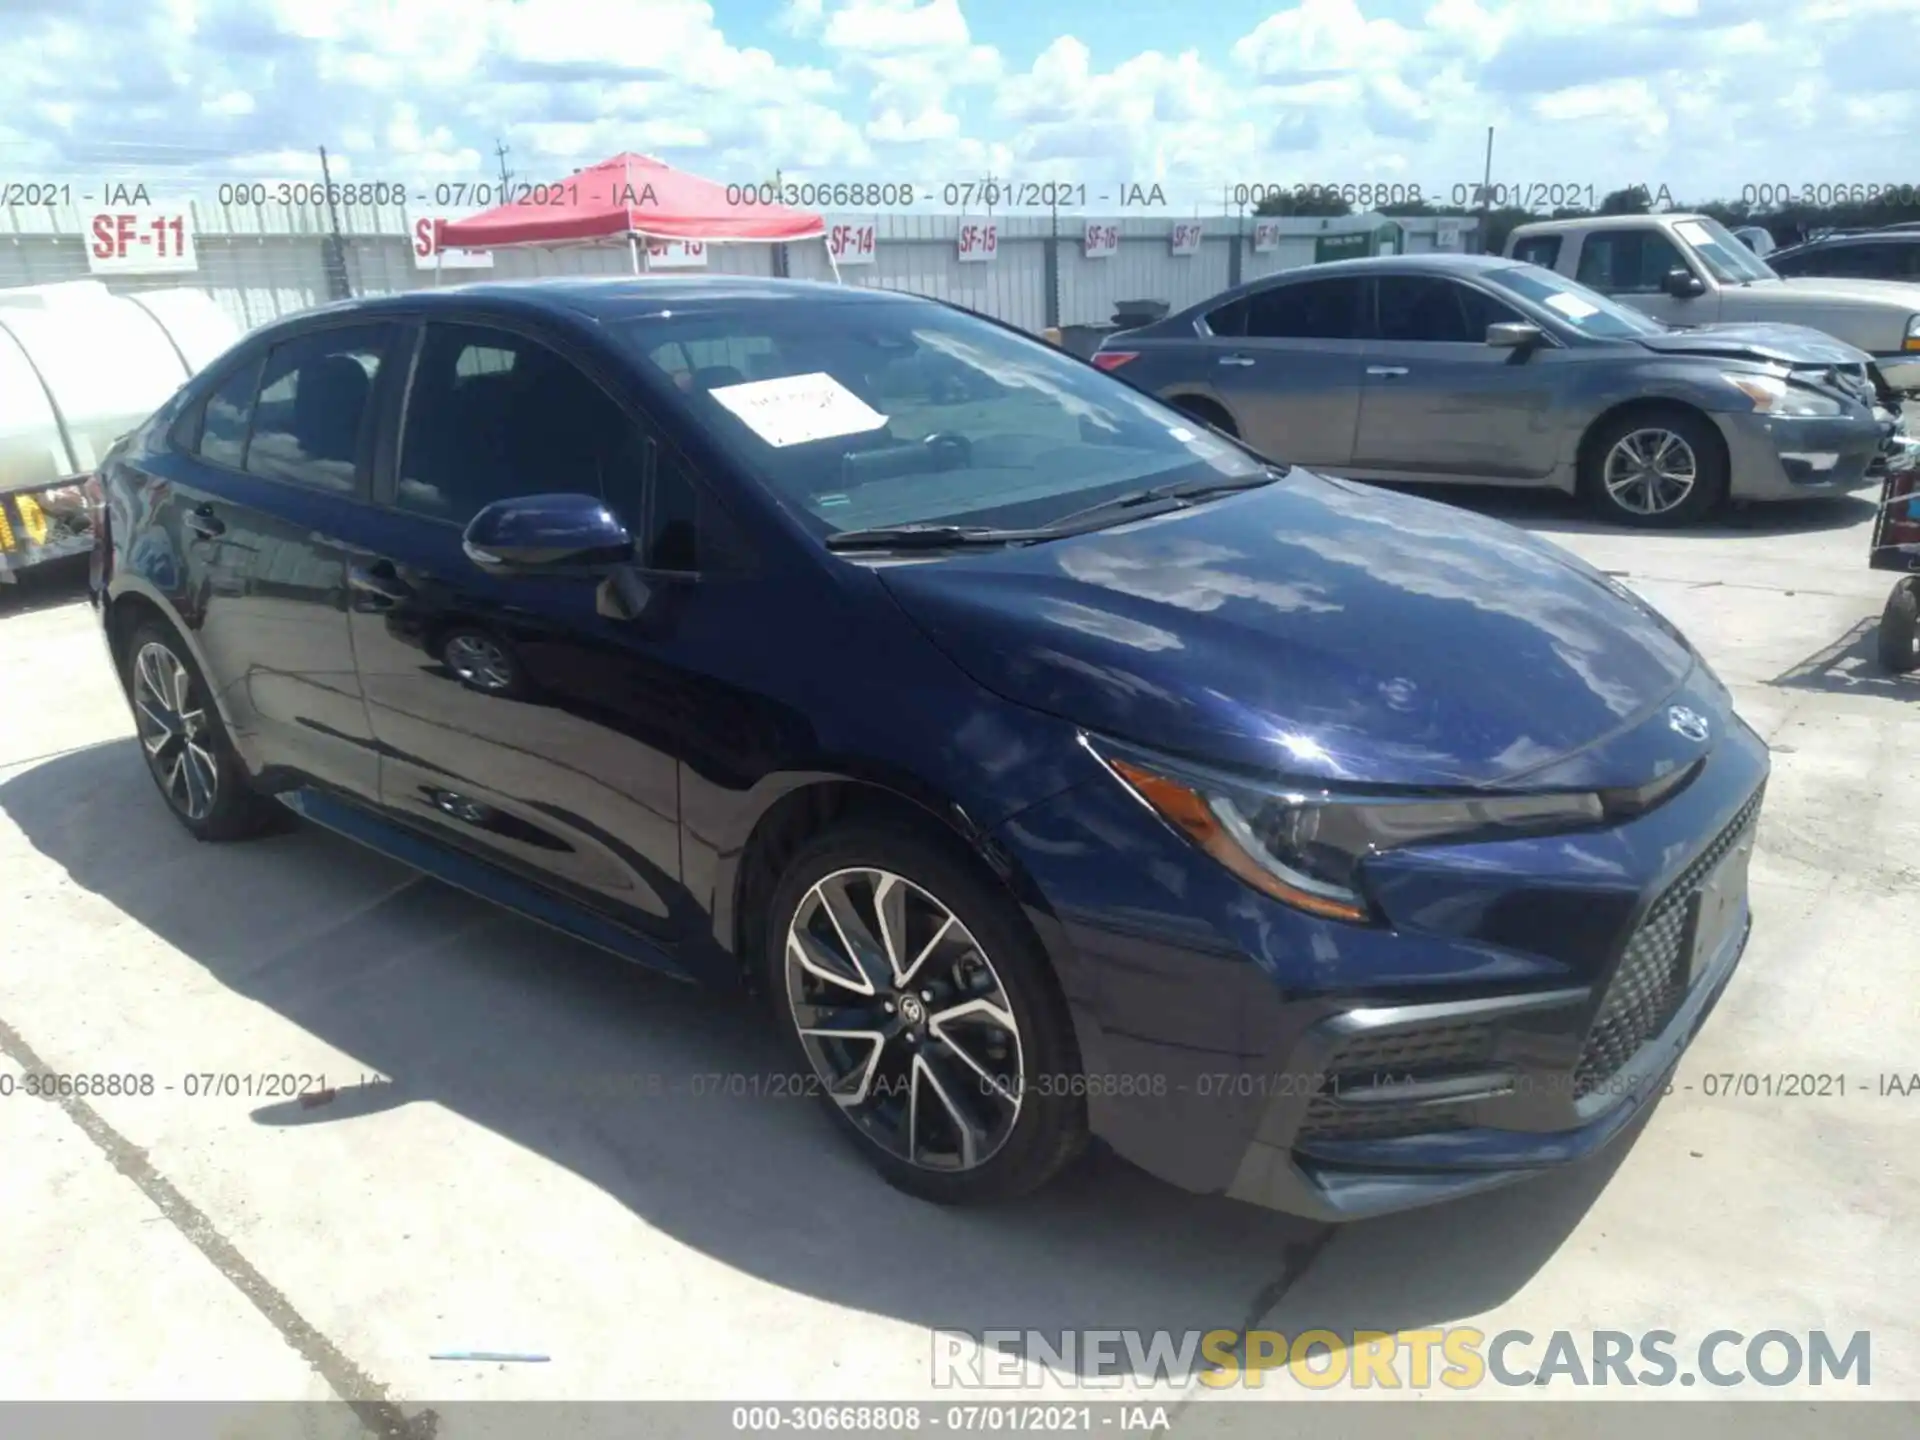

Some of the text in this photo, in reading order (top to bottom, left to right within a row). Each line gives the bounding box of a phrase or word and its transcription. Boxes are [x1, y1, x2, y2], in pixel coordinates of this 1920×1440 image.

[92, 214, 184, 258] SF-11
[830, 226, 873, 254] SF-14
[960, 226, 997, 253] SF-15
[1086, 225, 1117, 249] SF-16
